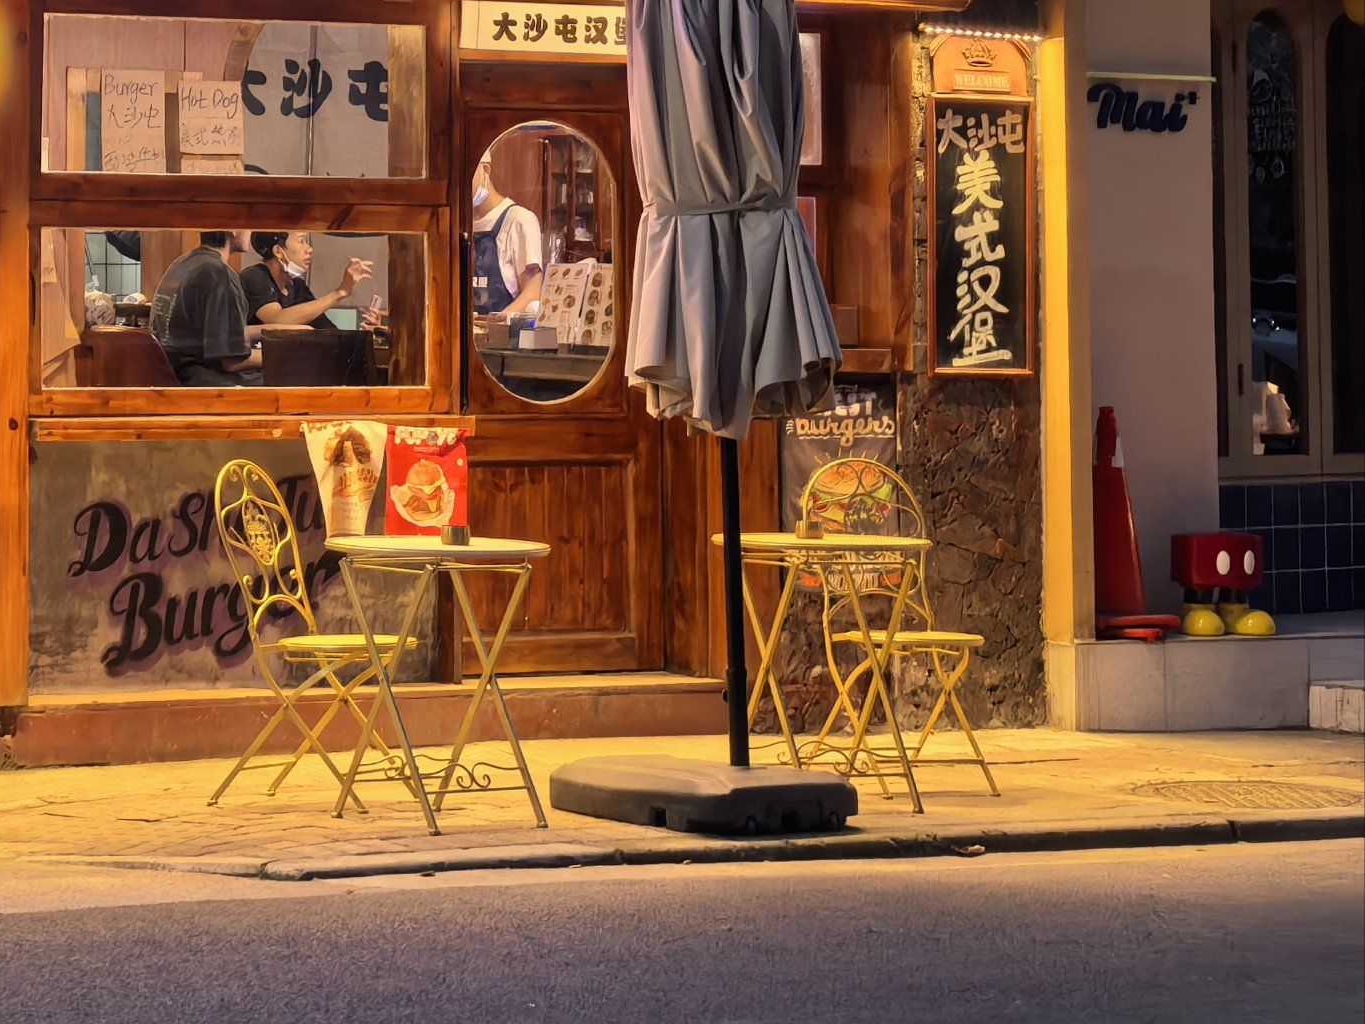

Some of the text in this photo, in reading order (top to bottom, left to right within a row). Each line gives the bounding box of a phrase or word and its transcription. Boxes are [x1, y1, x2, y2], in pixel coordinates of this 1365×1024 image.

[104, 74, 158, 104] Burger
[954, 73, 1010, 89] WELCOME
[212, 88, 239, 119] Dog
[937, 108, 1025, 154] 大沙屯
[948, 149, 1014, 367] 美式汉堡
